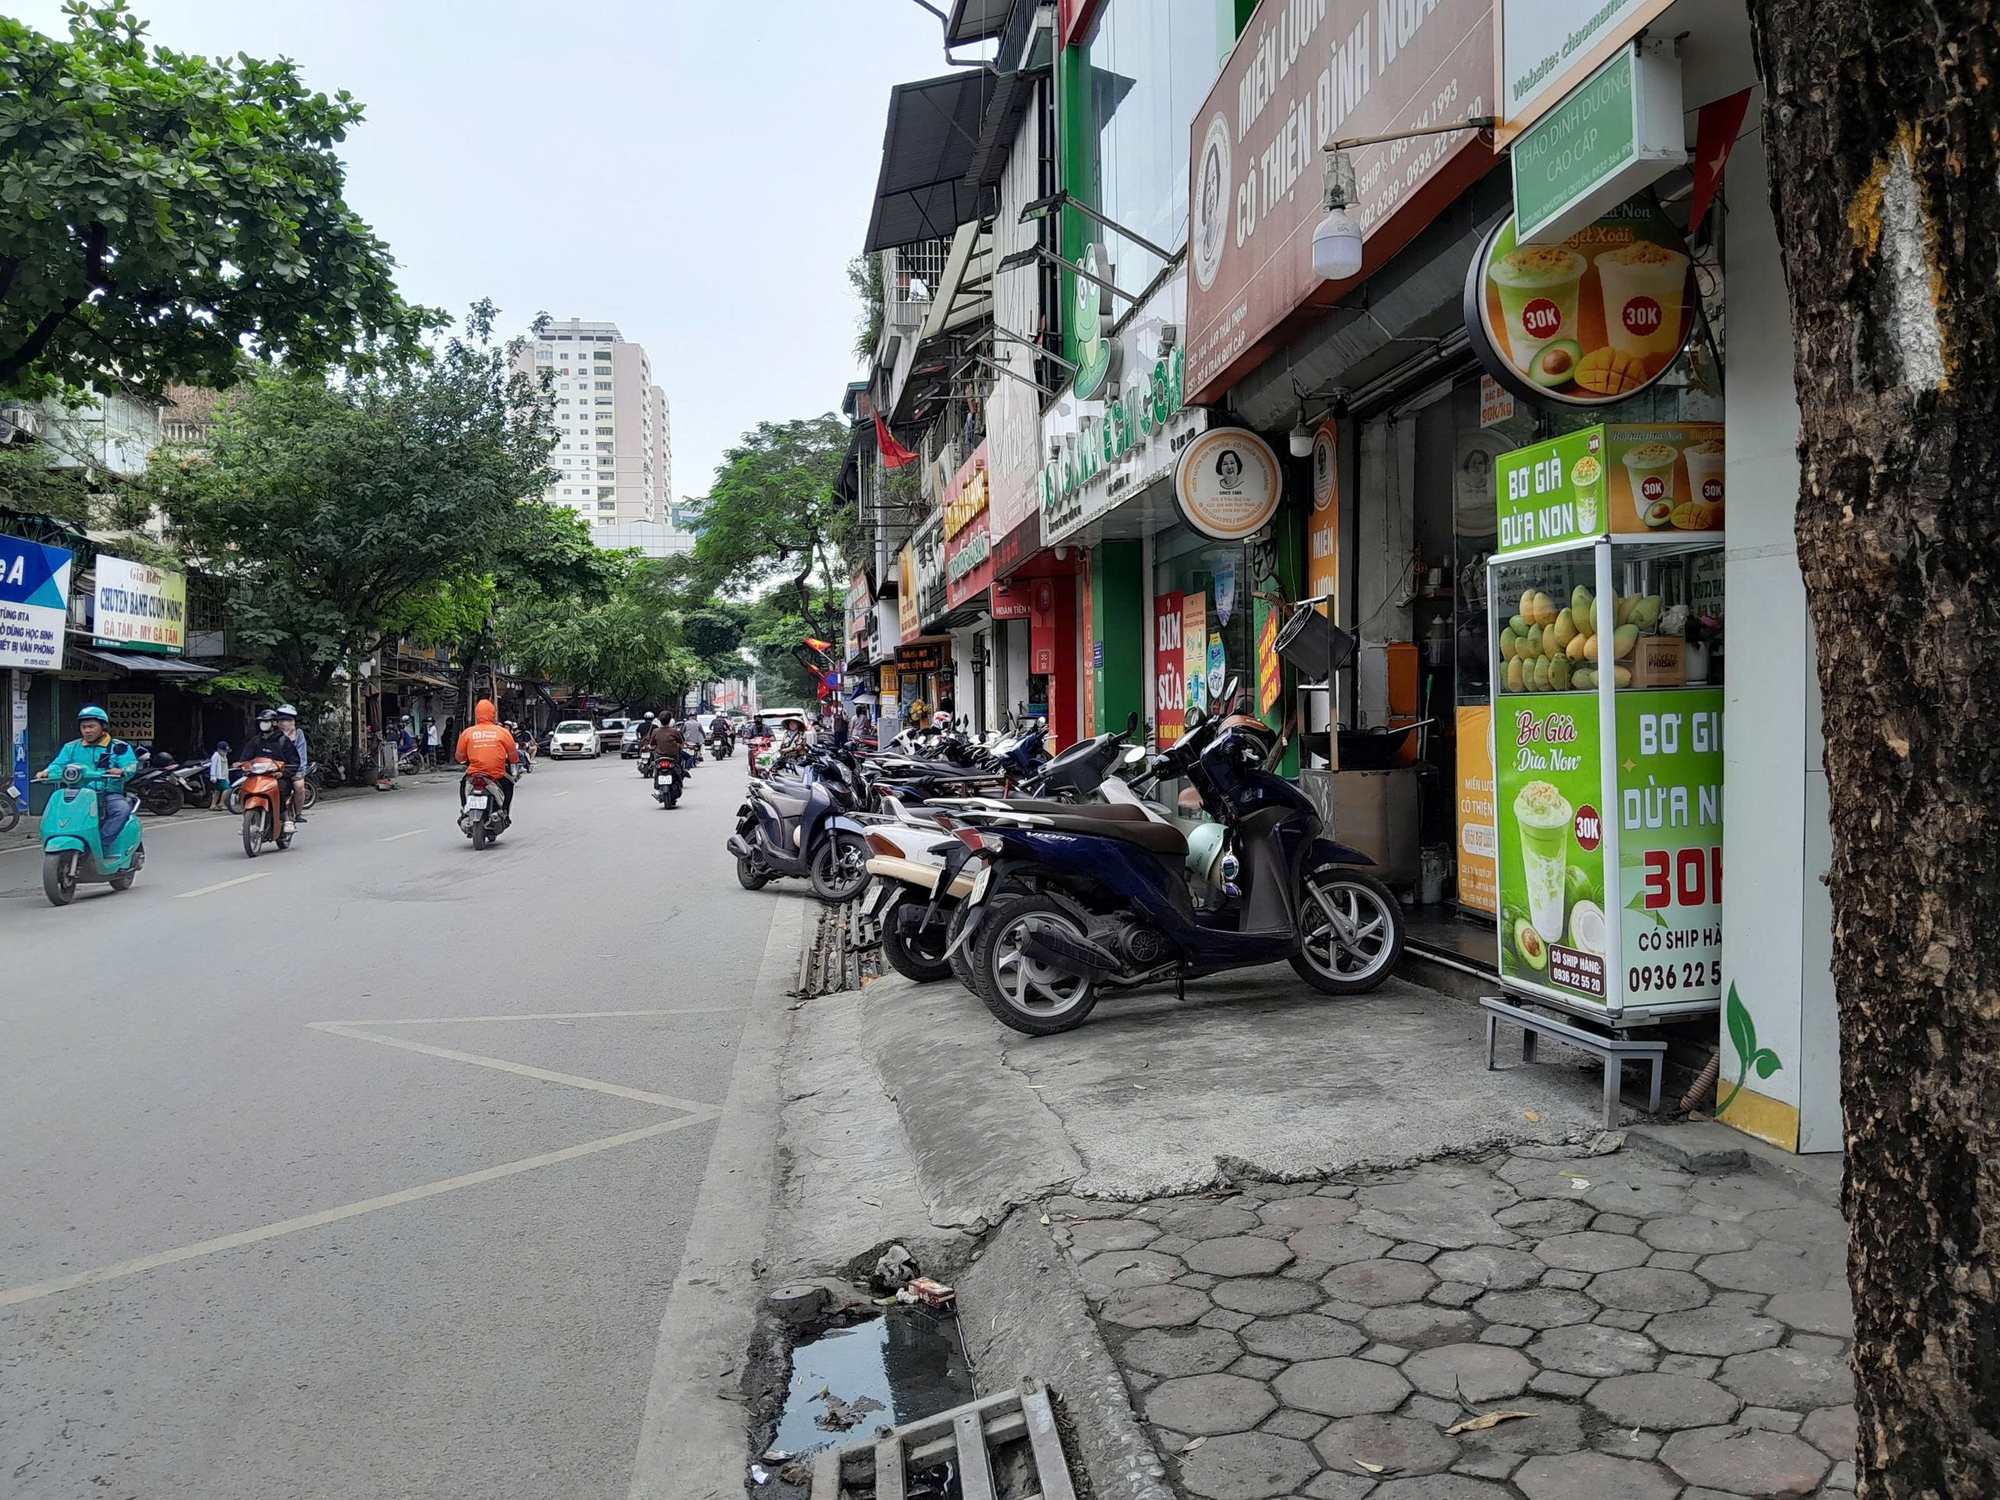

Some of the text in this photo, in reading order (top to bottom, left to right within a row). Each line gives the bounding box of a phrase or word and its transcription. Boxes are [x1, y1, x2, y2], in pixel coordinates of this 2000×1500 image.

[1238, 19, 1276, 145] MIẾN
[1513, 51, 1559, 101] Website:
[1236, 156, 1257, 249] CÔ
[1261, 91, 1311, 220] THIỆN
[1316, 9, 1370, 152] ĐÌNH
[1361, 161, 1381, 196] SHIP
[1431, 78, 1458, 122] 1993
[1550, 105, 1580, 147] DINH
[1546, 127, 1598, 182] CAO CẤP
[1377, 179, 1400, 217] 6289
[1406, 147, 1432, 187] 0936
[1434, 131, 1448, 162] 22
[1526, 307, 1558, 330] 30K
[1627, 307, 1658, 326] 30K
[1508, 448, 1562, 501] BƠ GIÀ
[1643, 483, 1663, 495] 30K
[1704, 485, 1722, 496] 30K
[1501, 502, 1574, 547] DỪA NON
[130, 566, 144, 582] Gia
[129, 585, 148, 617] BÁNH
[148, 587, 166, 620] CUỐN
[17, 611, 30, 623] STA
[1159, 598, 1182, 651] BỈM
[25, 629, 40, 641] HỌC
[40, 630, 54, 641] SINH
[33, 641, 55, 655] PHÒNG
[1648, 653, 1676, 661] SEVEN
[1648, 660, 1677, 668] FRIDAY
[1158, 661, 1184, 711] SỮA
[110, 700, 153, 709] BÁNH
[110, 710, 152, 719] CUỐN
[109, 719, 153, 729] NÓNG
[1545, 713, 1578, 743] Già
[1640, 712, 1724, 755] BƠ GI
[1517, 748, 1547, 771] Dừa
[1461, 796, 1493, 818] CÔ THIỆN
[1623, 775, 1688, 830] DỪA
[1577, 816, 1599, 840] 30K
[1638, 927, 1662, 952] CÓ
[1666, 927, 1699, 949] SHIP
[1552, 950, 1602, 975] CÓ SHIP HÀNG:
[1553, 967, 1601, 991] 0936 22 55 20
[1629, 964, 1677, 993] 0936
[1683, 962, 1705, 988] 22
